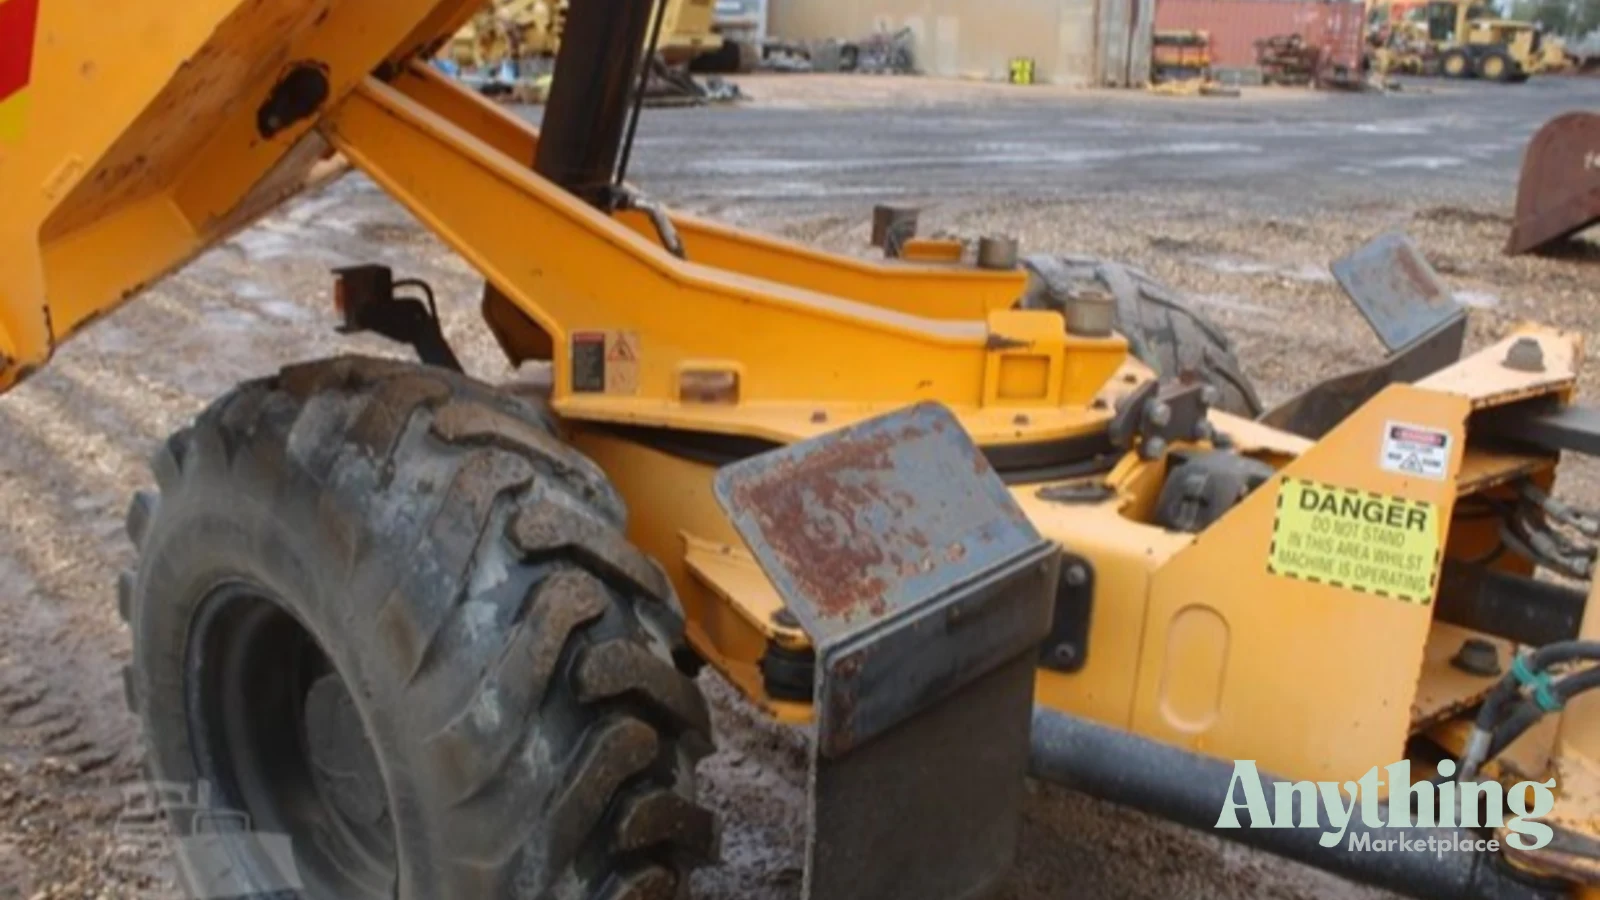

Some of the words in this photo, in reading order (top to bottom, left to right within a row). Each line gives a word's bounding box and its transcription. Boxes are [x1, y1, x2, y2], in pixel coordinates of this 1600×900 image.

[1299, 488, 1428, 532] DANGER
[1287, 531, 1302, 547] IN
[1305, 534, 1334, 554] THIS
[1337, 541, 1370, 561] AREA
[1372, 547, 1424, 571] WHILST
[1311, 515, 1331, 534] DO
[1333, 520, 1361, 540] NOT
[1363, 526, 1406, 548] STAND
[1278, 550, 1335, 575] MACHINE
[1338, 562, 1351, 578] IS
[1353, 564, 1428, 593] OPERATING
